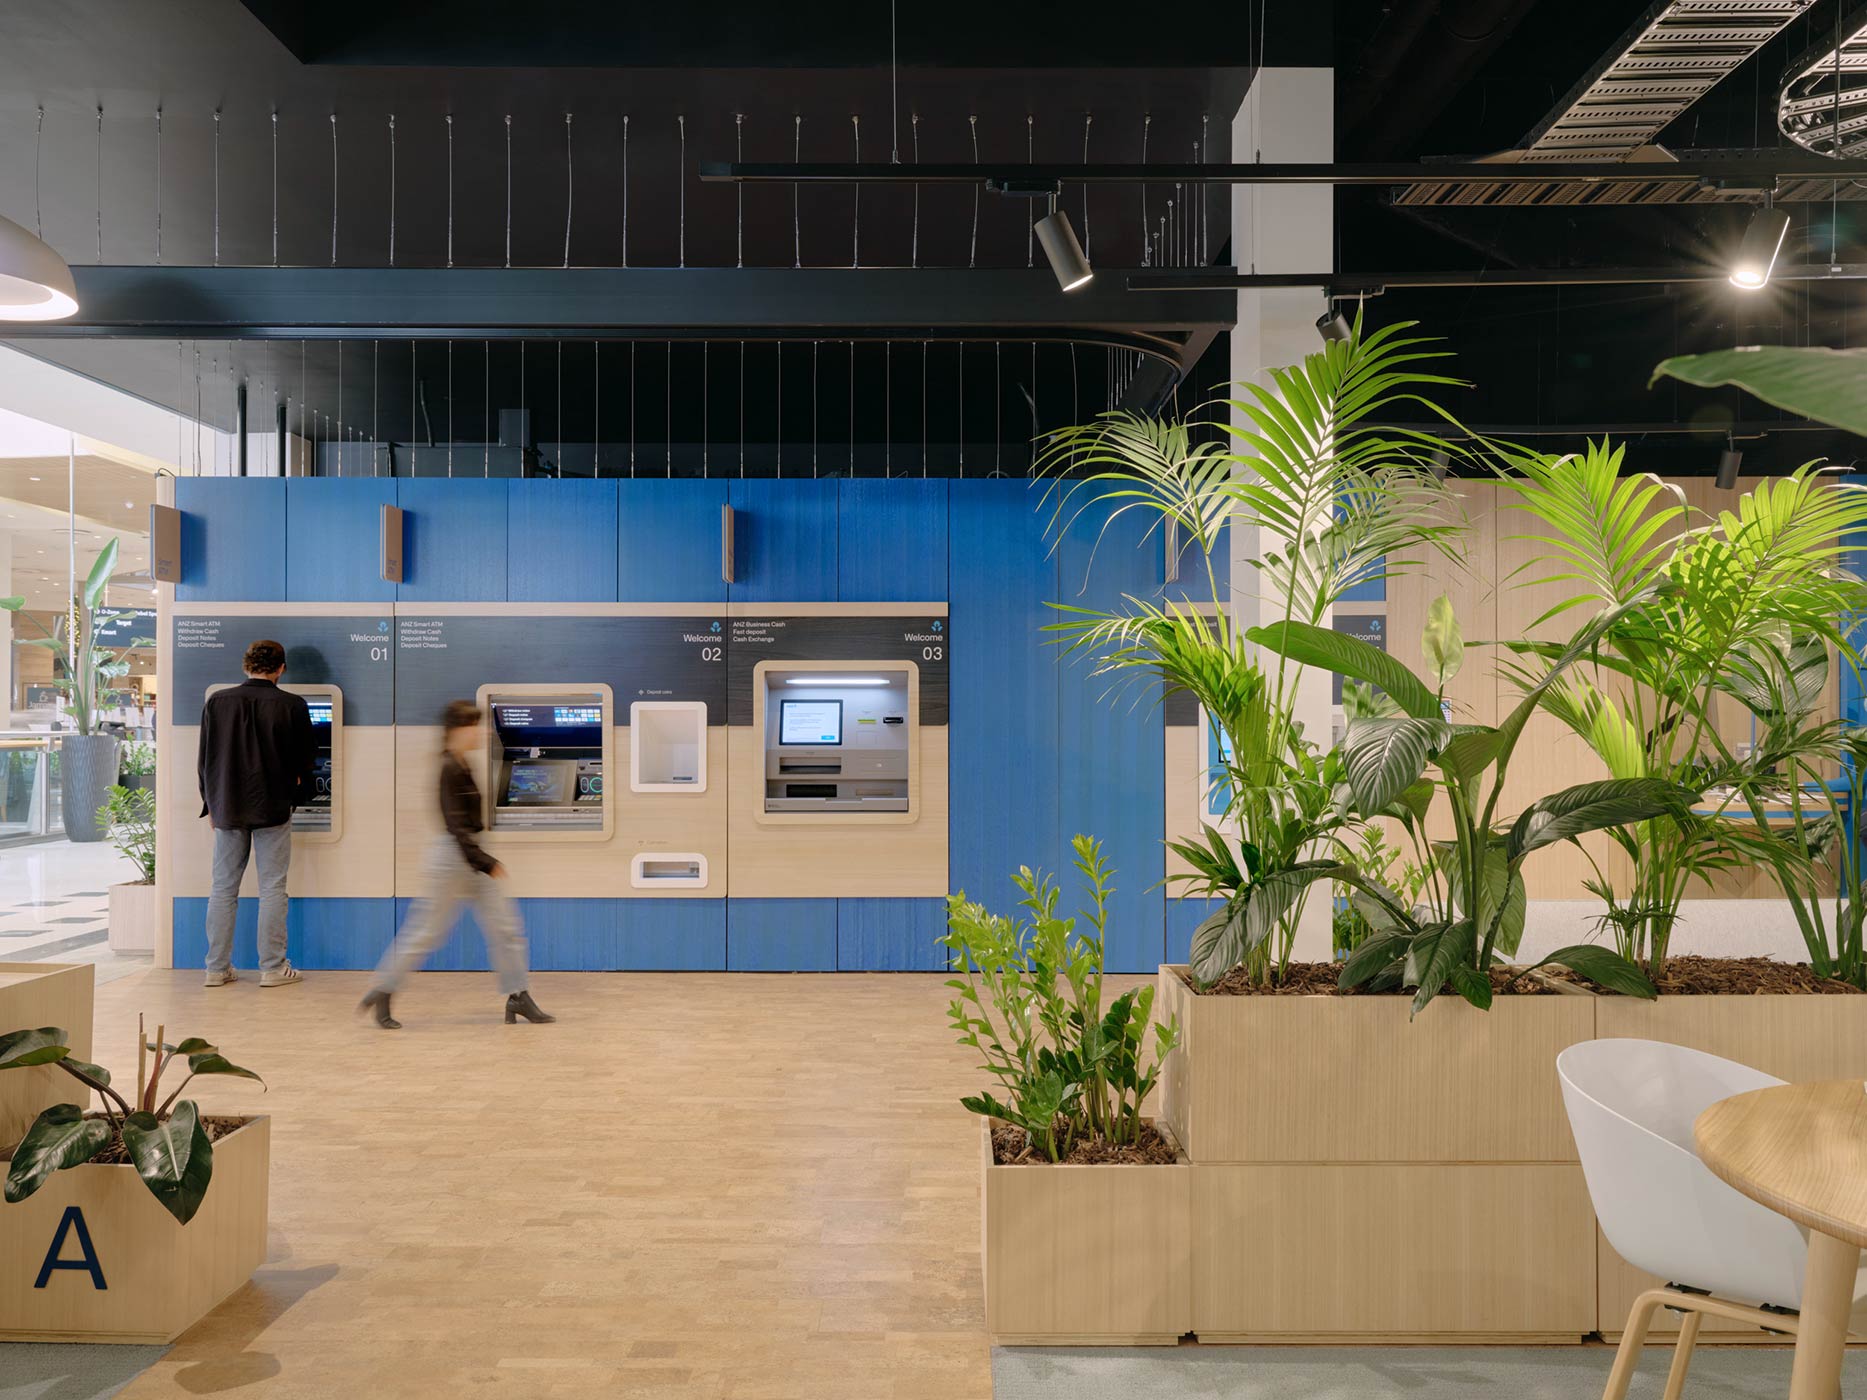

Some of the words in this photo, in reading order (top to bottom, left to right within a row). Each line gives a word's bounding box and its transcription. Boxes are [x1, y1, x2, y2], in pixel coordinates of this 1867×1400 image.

[351, 633, 389, 642] Welcome
[683, 634, 722, 642] Welcome
[904, 633, 943, 642] Welcome
[371, 647, 388, 661] 01
[702, 647, 722, 661] 02
[923, 646, 943, 661] 03
[34, 1206, 108, 1290] A
